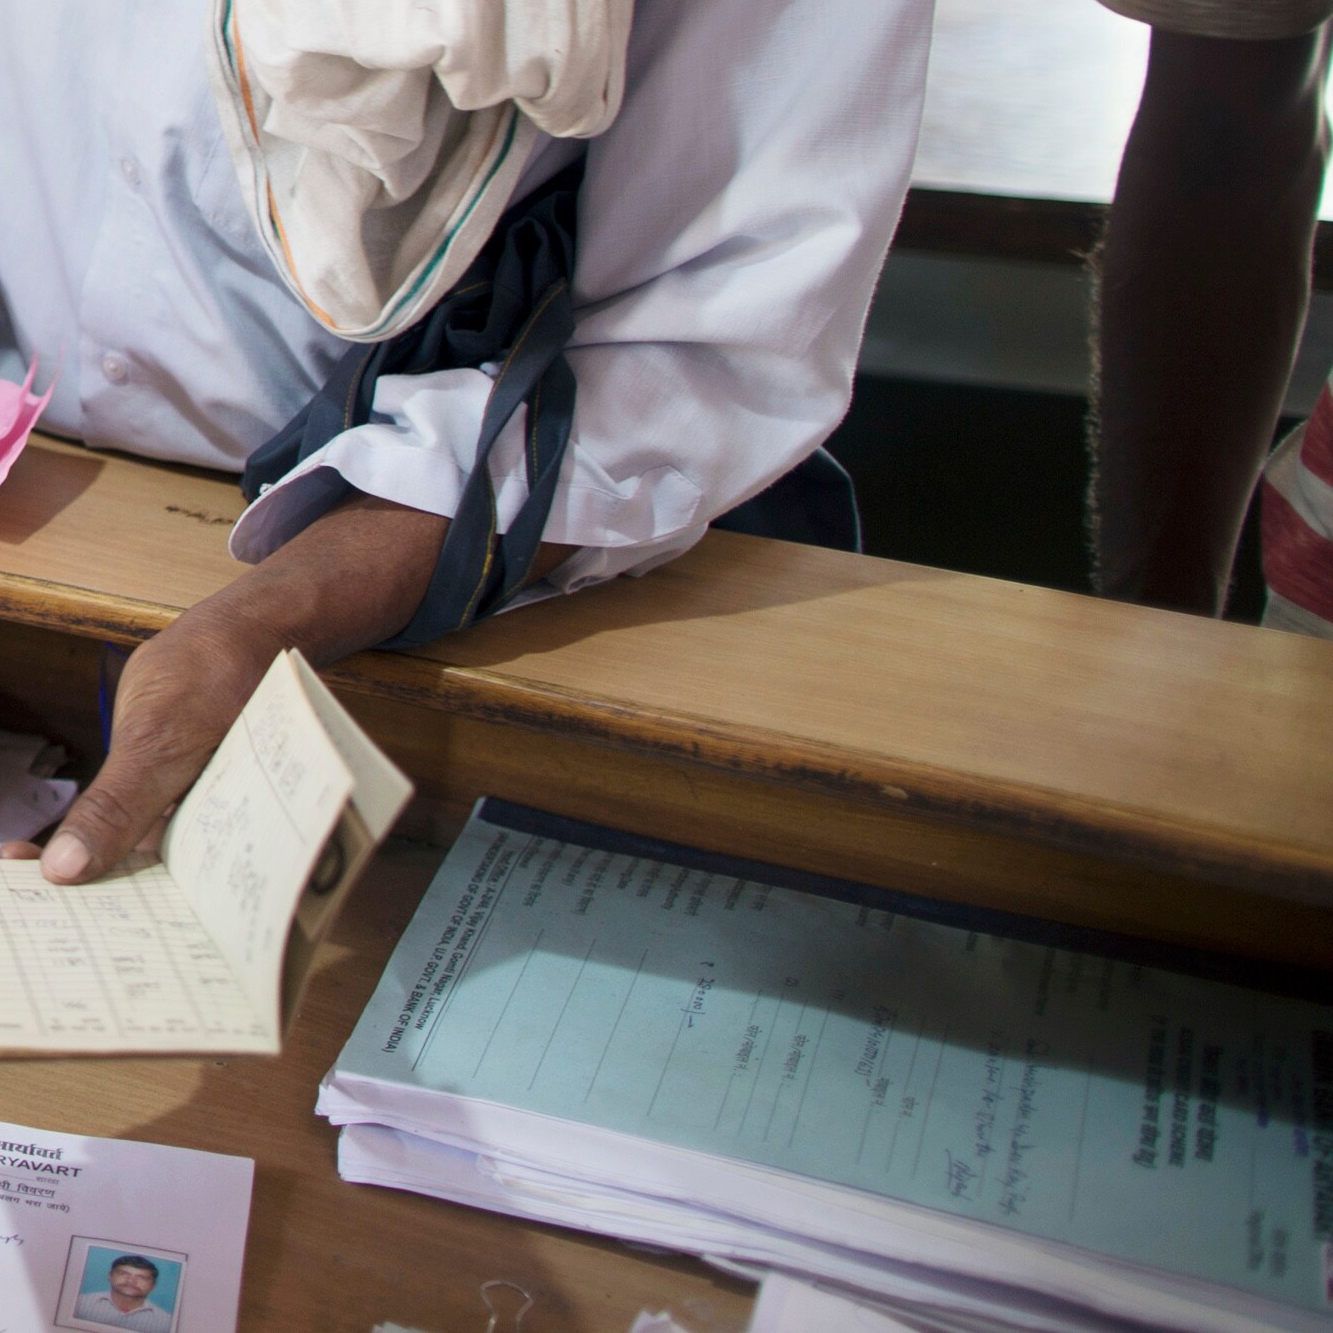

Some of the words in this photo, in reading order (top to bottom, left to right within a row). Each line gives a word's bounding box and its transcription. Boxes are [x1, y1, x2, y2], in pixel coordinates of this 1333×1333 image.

[465, 884, 480, 895] OF
[455, 894, 474, 915] GOVT
[450, 915, 464, 926] OF
[465, 910, 486, 929] Vijay
[436, 926, 460, 947] INDIA,
[453, 929, 477, 951] Khand,
[431, 947, 447, 962] U.P.
[445, 952, 466, 973] Gomti
[419, 962, 441, 983] GOVT.
[431, 973, 455, 996] Nagar,
[402, 991, 423, 1013] BANK
[397, 1013, 412, 1027] OF
[414, 997, 440, 1030] Lucknow
[381, 1026, 407, 1054] INDIA)
[1173, 1092, 1191, 1123] CARD
[1168, 1124, 1188, 1169] SCHEME
[17, 1182, 57, 1199] विवरण
